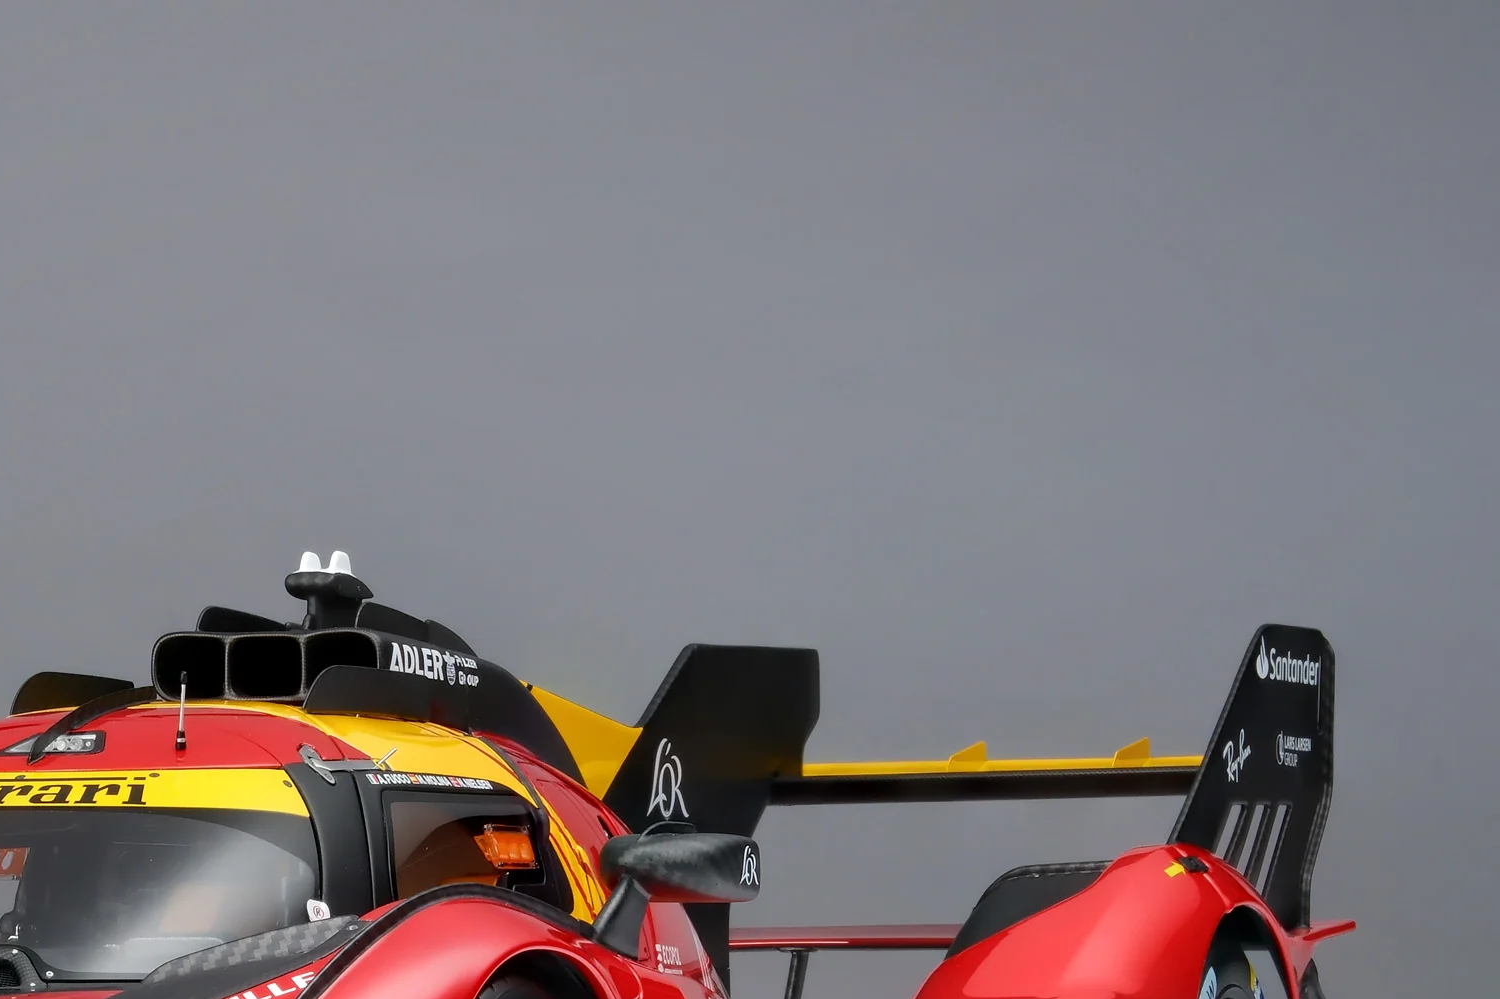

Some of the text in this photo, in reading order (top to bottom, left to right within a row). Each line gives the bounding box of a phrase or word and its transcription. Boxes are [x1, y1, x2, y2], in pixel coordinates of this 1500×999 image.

[389, 642, 444, 681] ADLER
[1269, 647, 1319, 686] Santander
[1284, 735, 1312, 751] LARS LARSEN
[1284, 754, 1298, 767] GROUP
